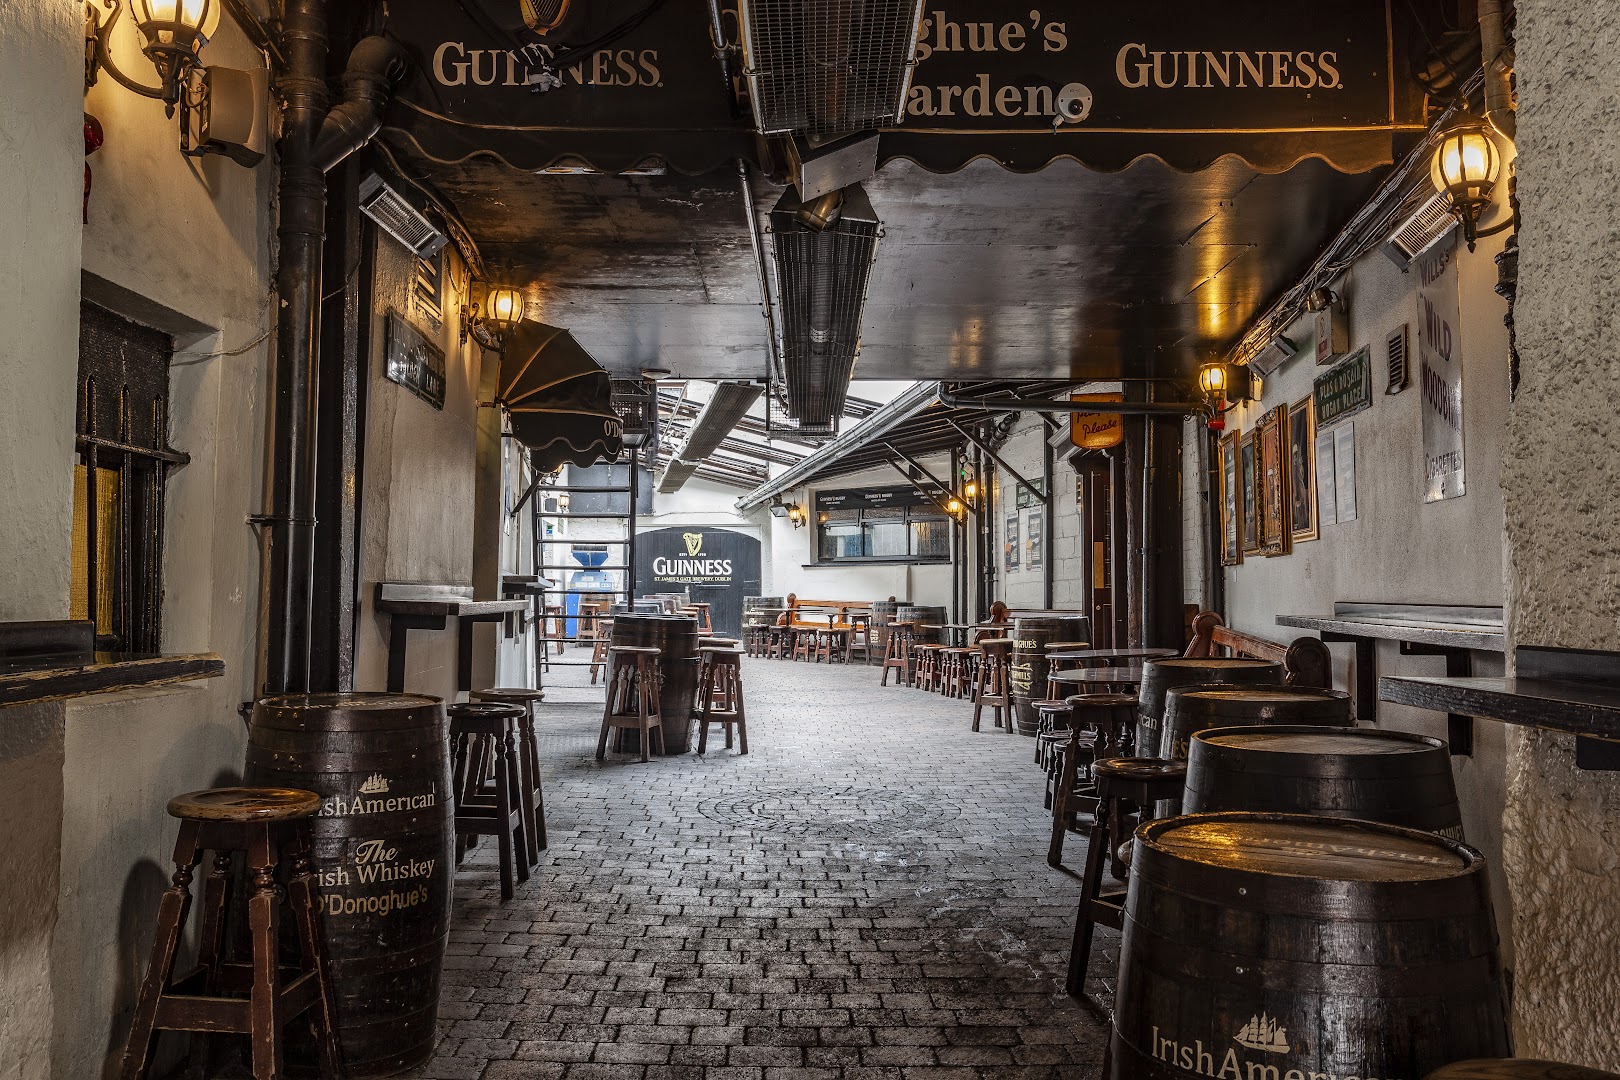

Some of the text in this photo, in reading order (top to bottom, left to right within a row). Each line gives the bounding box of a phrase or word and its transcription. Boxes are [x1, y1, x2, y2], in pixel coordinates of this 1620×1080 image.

[1115, 43, 1341, 90] GUINNESS
[1342, 385, 1362, 409] PLACE
[1082, 420, 1118, 440] Please
[1425, 450, 1462, 480] CIGARETTES
[653, 557, 732, 575] GUINNESS
[354, 839, 399, 865] The
[356, 858, 436, 884] Whiskey
